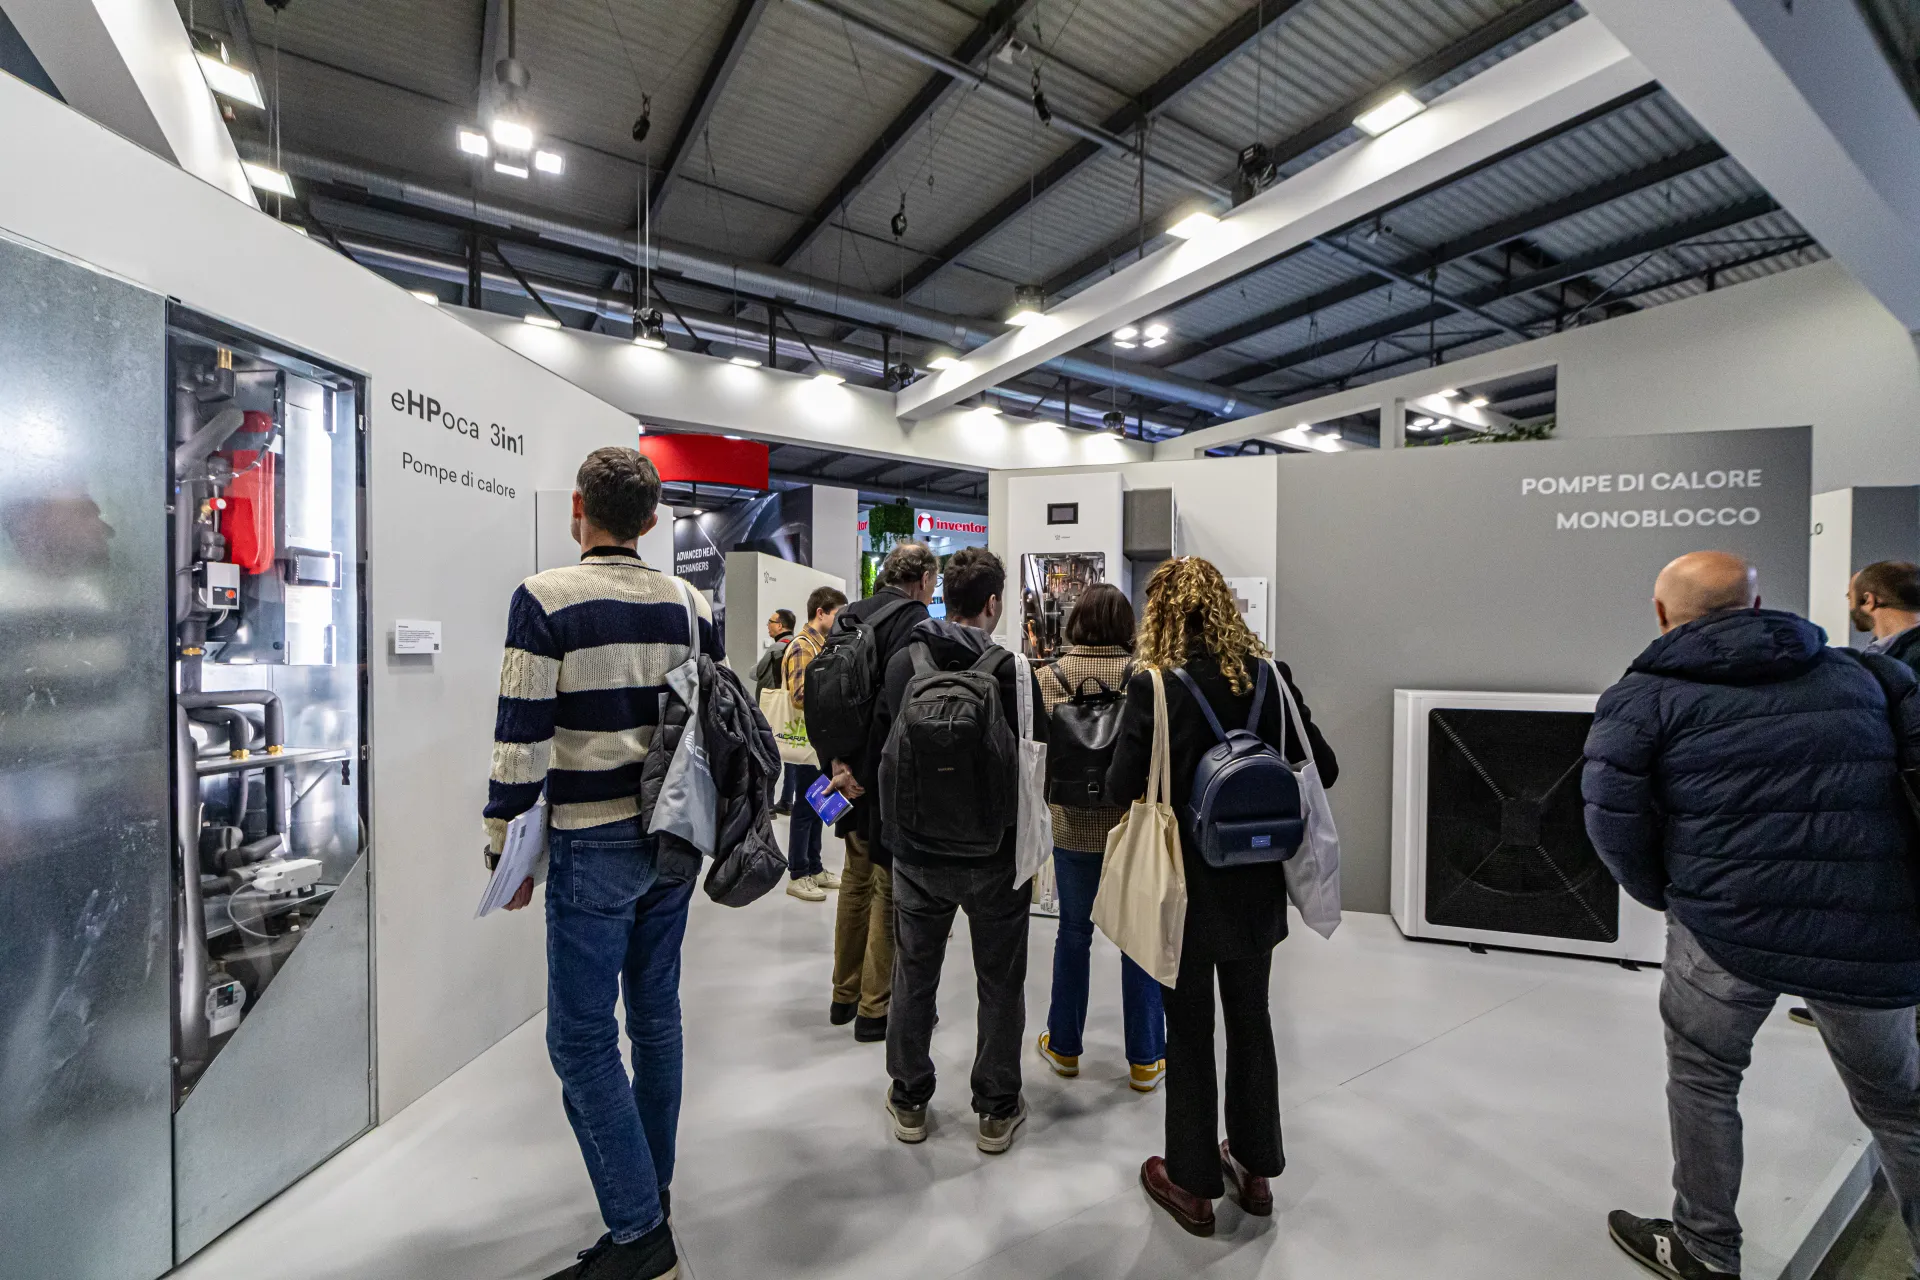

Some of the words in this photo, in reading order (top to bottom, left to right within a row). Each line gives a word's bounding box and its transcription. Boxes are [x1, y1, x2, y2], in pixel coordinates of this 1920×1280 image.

[391, 388, 479, 440] eHPoca
[490, 423, 524, 456] 3in1
[402, 451, 457, 484] Pompe
[461, 470, 474, 488] di
[477, 477, 516, 499] calore
[1521, 474, 1612, 495] POMPE
[1617, 473, 1645, 493] DI
[1650, 469, 1763, 491] CALORE
[936, 517, 987, 534] inventor
[1556, 507, 1761, 530] MONOBLOCCO
[676, 548, 703, 562] ADVANCED
[702, 545, 717, 558] HEAT
[676, 561, 709, 575] EXCHANGERS
